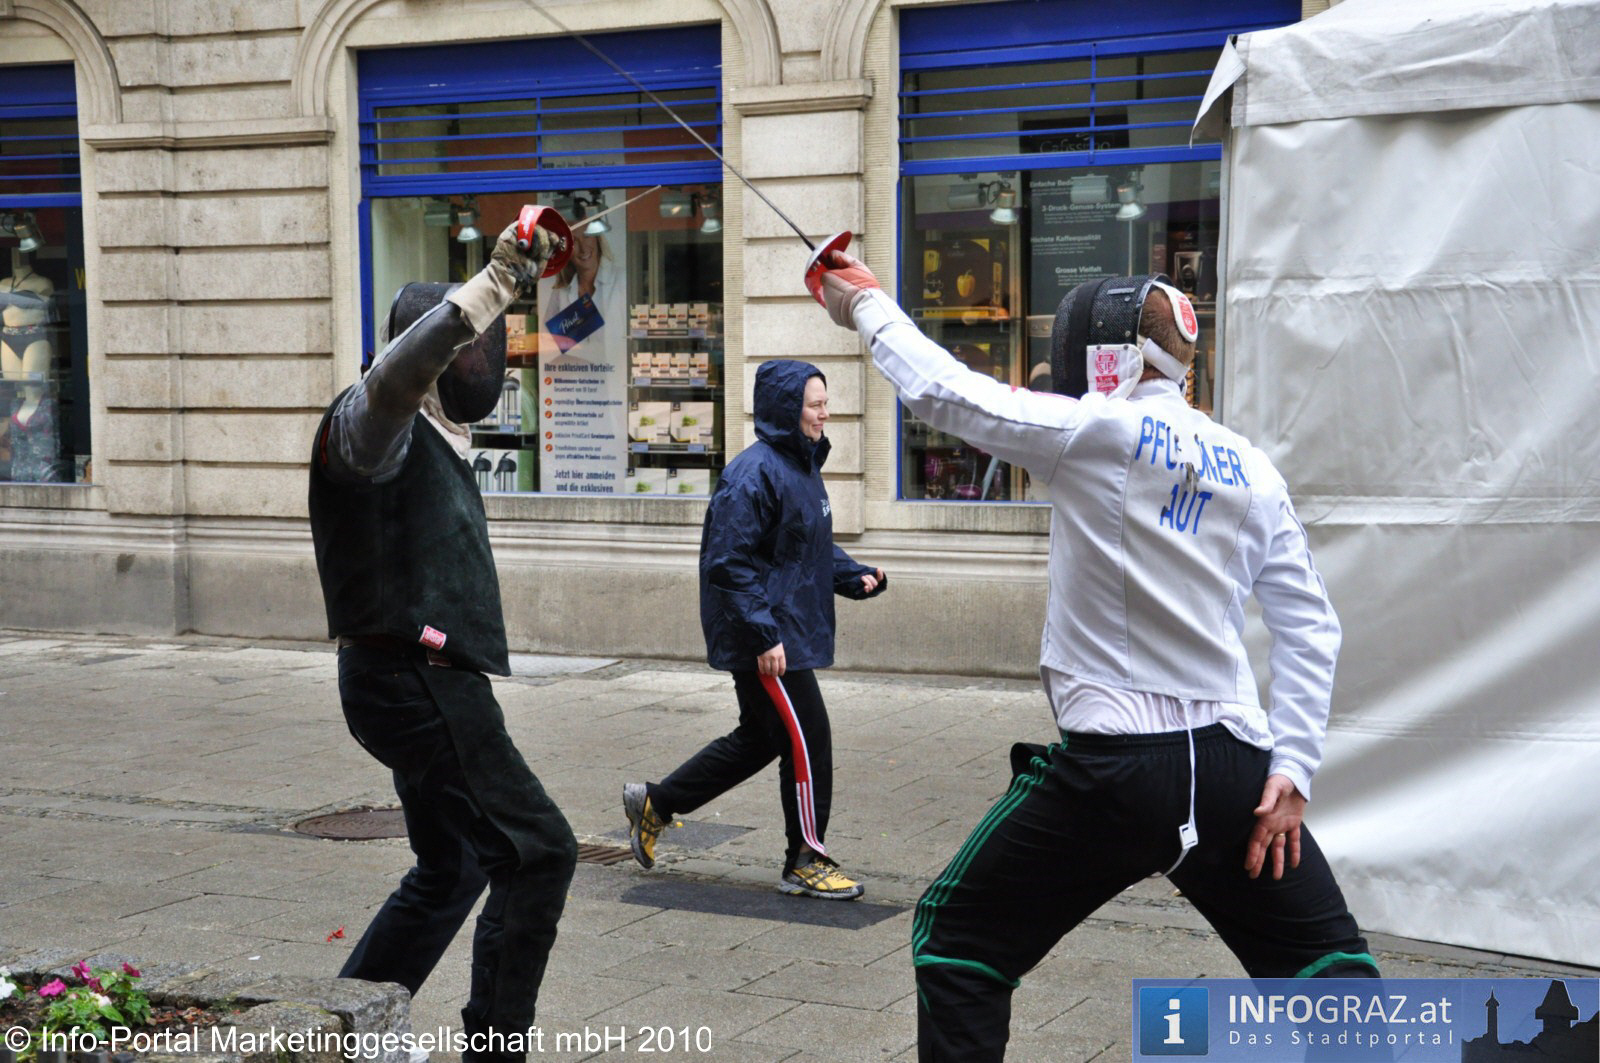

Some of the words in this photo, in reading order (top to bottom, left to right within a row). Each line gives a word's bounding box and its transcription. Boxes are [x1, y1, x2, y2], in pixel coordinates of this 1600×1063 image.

[1055, 266, 1077, 274] Grosse
[1079, 265, 1102, 273] Vielfalt
[544, 363, 556, 372] Ihre
[558, 363, 589, 372] exklusiven
[554, 470, 570, 478] Jetzt
[571, 470, 583, 479] hier
[586, 471, 615, 480] anmelden
[556, 483, 568, 491] und
[569, 483, 578, 492] die
[580, 483, 614, 493] exklusiven
[1159, 483, 1213, 535] AUT
